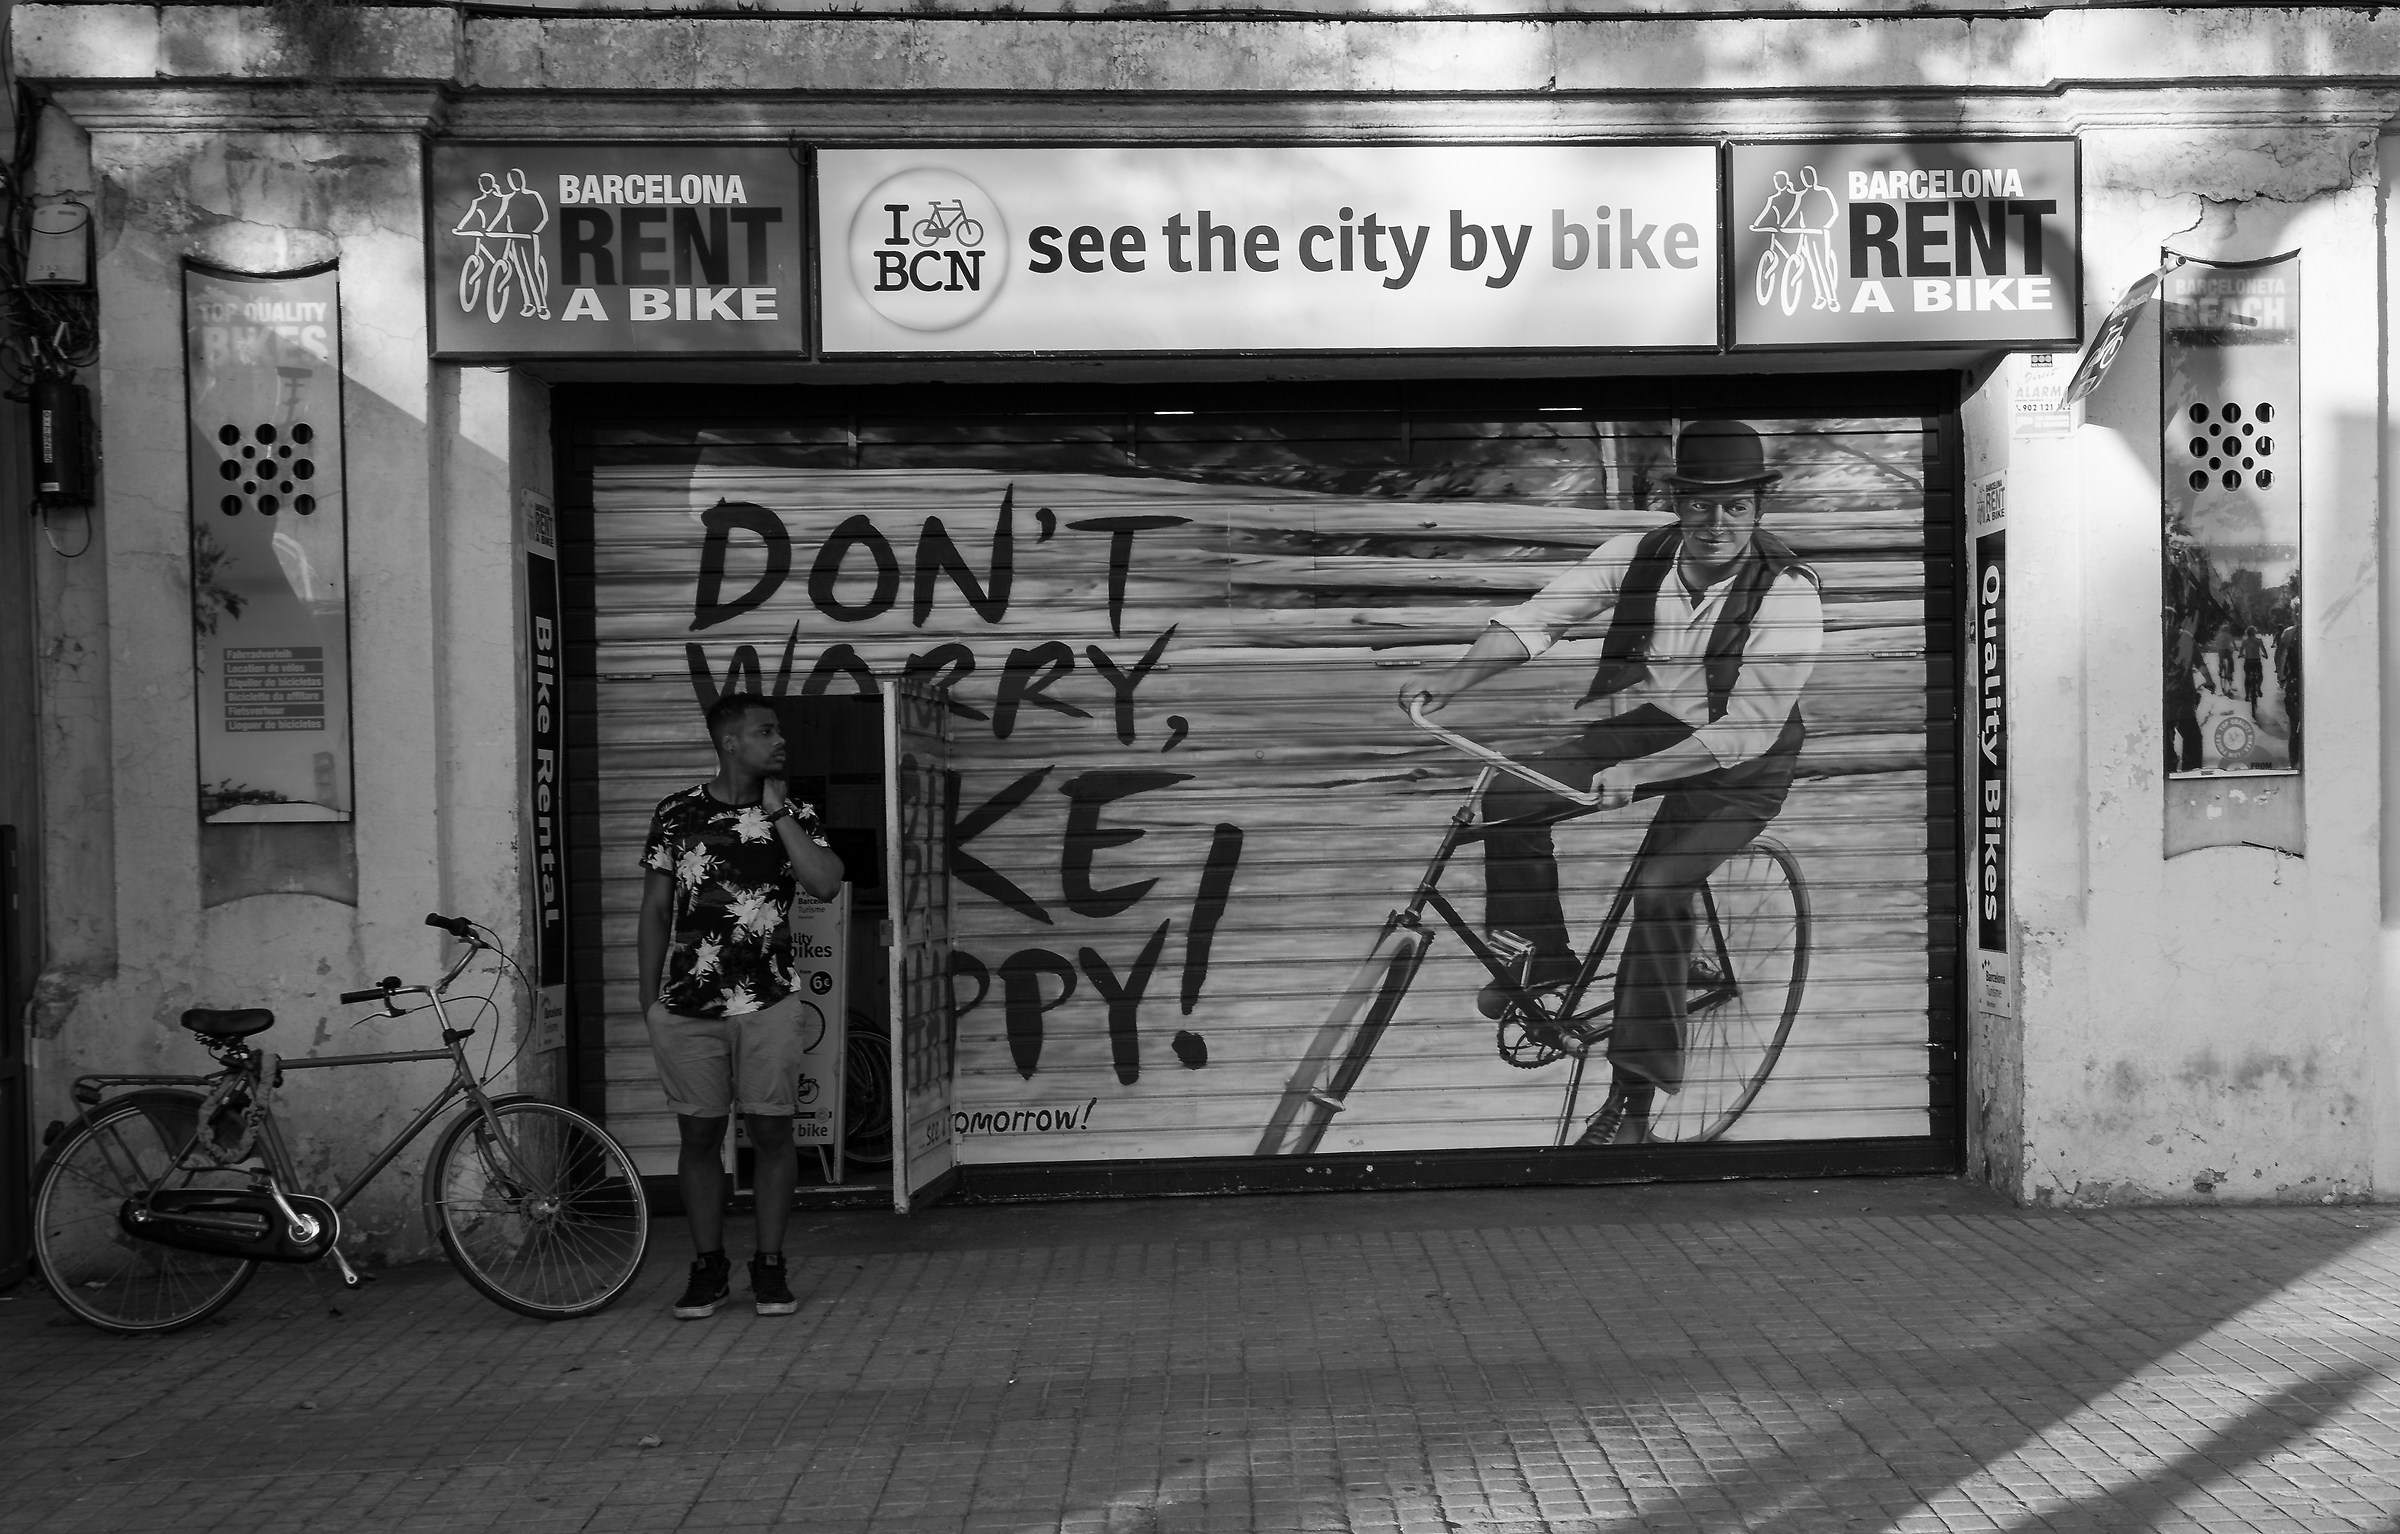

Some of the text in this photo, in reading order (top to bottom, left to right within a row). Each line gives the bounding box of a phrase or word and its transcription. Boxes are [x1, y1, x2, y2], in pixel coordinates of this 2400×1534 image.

[558, 174, 748, 205] BARCELONA
[1848, 168, 2024, 200] BARCELONA
[884, 204, 909, 245] I
[1849, 200, 2056, 278] RENT
[559, 206, 783, 286] RENT
[1028, 205, 1699, 290] see the city by bike
[873, 250, 985, 292] BCN
[2175, 278, 2286, 295] BARCELONETA
[198, 302, 327, 322] TOP QUALITY
[560, 288, 778, 321] A BIKE
[1849, 278, 2052, 313] A BIKE
[2177, 296, 2286, 330] BEACH
[203, 324, 328, 362] BIKES
[2016, 386, 2068, 398] ALARM
[1986, 487, 2005, 513] RENT
[1992, 508, 2005, 520] BIKE
[535, 511, 552, 539] RENT
[689, 482, 1194, 638] DON'T
[264, 678, 276, 686] de
[278, 677, 321, 686] bicicletas
[535, 615, 553, 734] Bike
[1982, 565, 2001, 766] Quality
[264, 721, 276, 729] de
[537, 748, 560, 929] Rental
[1984, 779, 2001, 921] Bikes
[797, 905, 825, 913] Turisme
[798, 1123, 828, 1138] bike
[952, 1097, 1097, 1136] omorrow!
